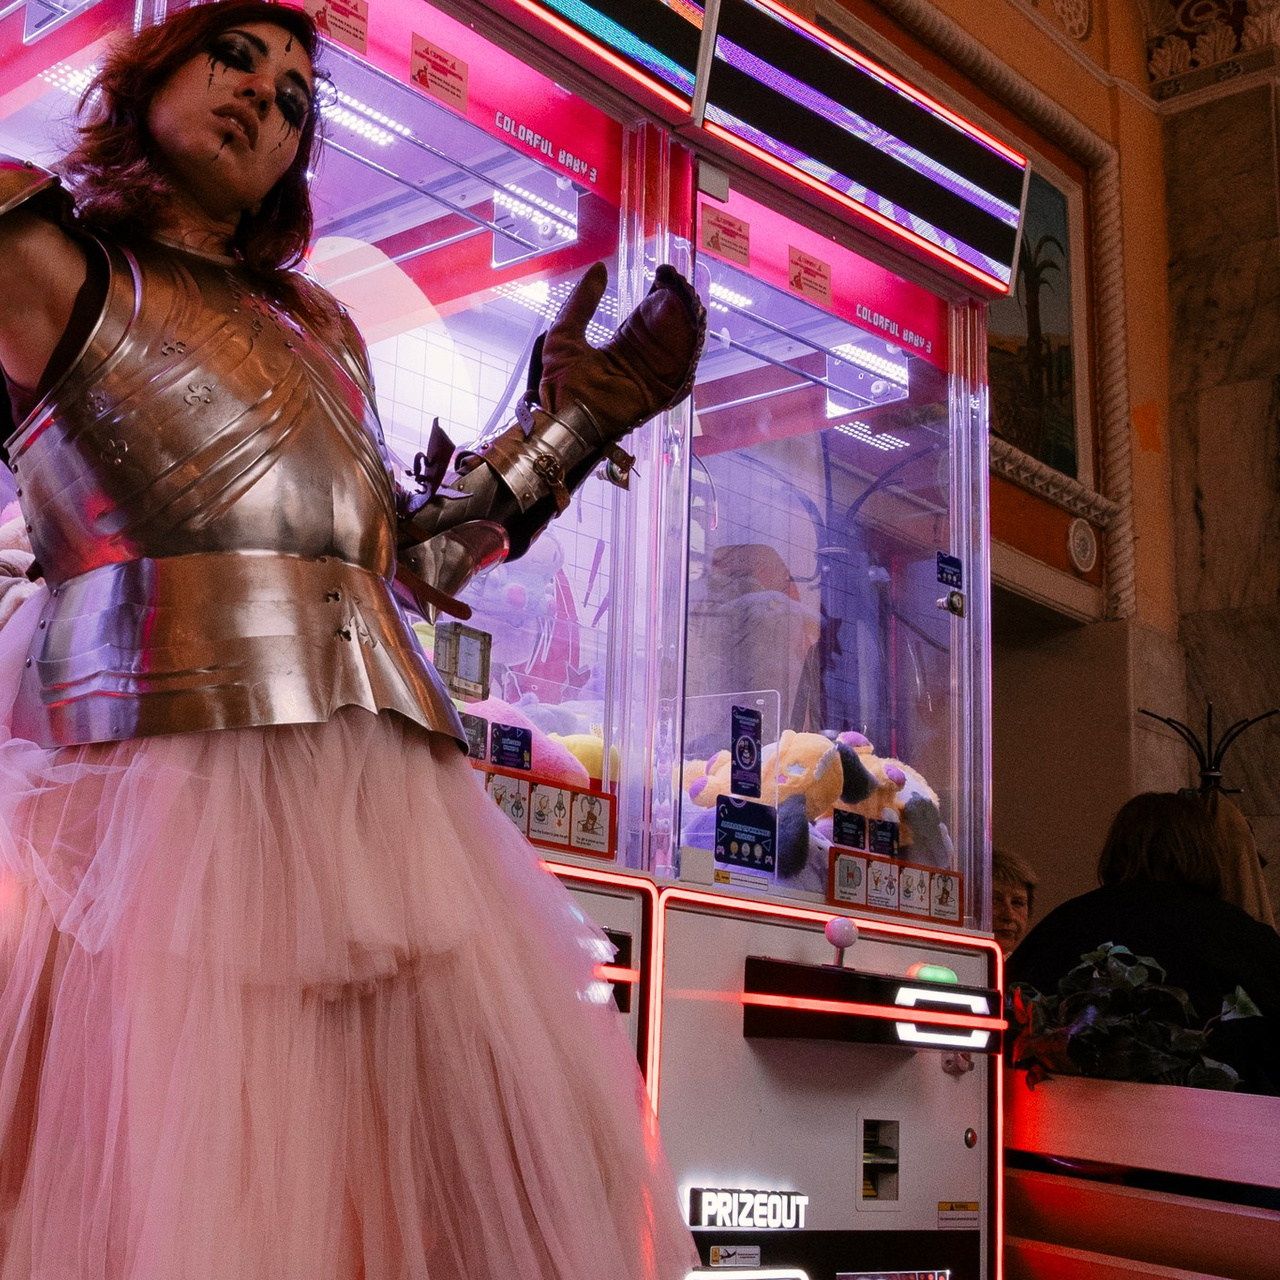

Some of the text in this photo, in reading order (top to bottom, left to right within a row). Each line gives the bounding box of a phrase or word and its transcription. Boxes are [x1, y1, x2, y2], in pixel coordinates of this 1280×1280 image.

[495, 111, 598, 183] COLORFUL BABY 3
[856, 304, 932, 354] COLORFUL BABY 3
[701, 1191, 809, 1228] PRIZEOUT
